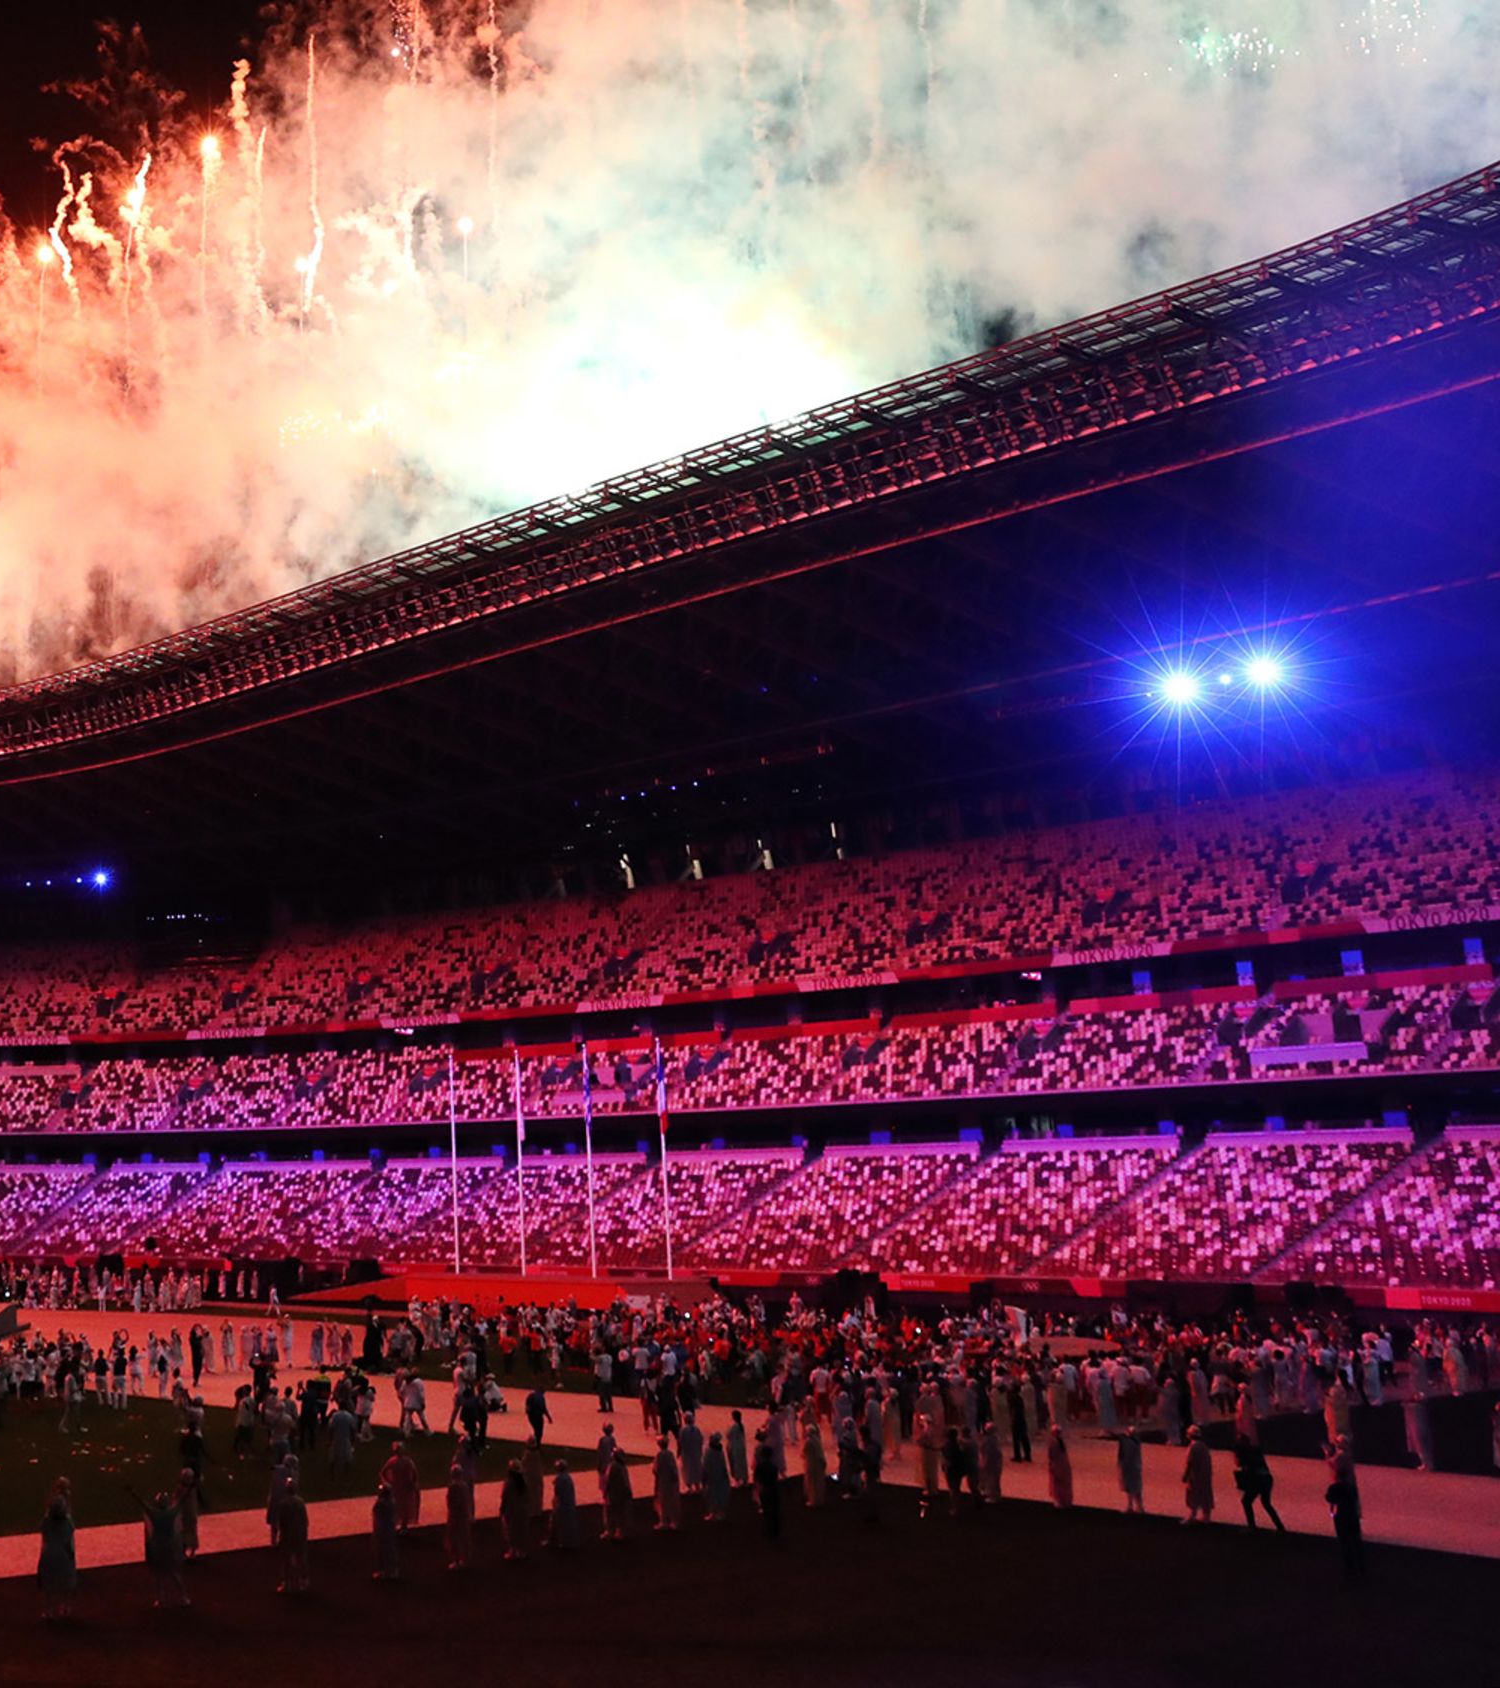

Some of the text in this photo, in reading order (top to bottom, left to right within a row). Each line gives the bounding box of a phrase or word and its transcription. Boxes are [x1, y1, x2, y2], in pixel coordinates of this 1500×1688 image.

[1385, 907, 1489, 931] TOKYO 2020
[1072, 943, 1153, 966] TOKYO 2020
[813, 973, 881, 991] TOKYO 2020
[590, 995, 650, 1012] TOKYO 2020
[1421, 1295, 1449, 1305] TOKYO
